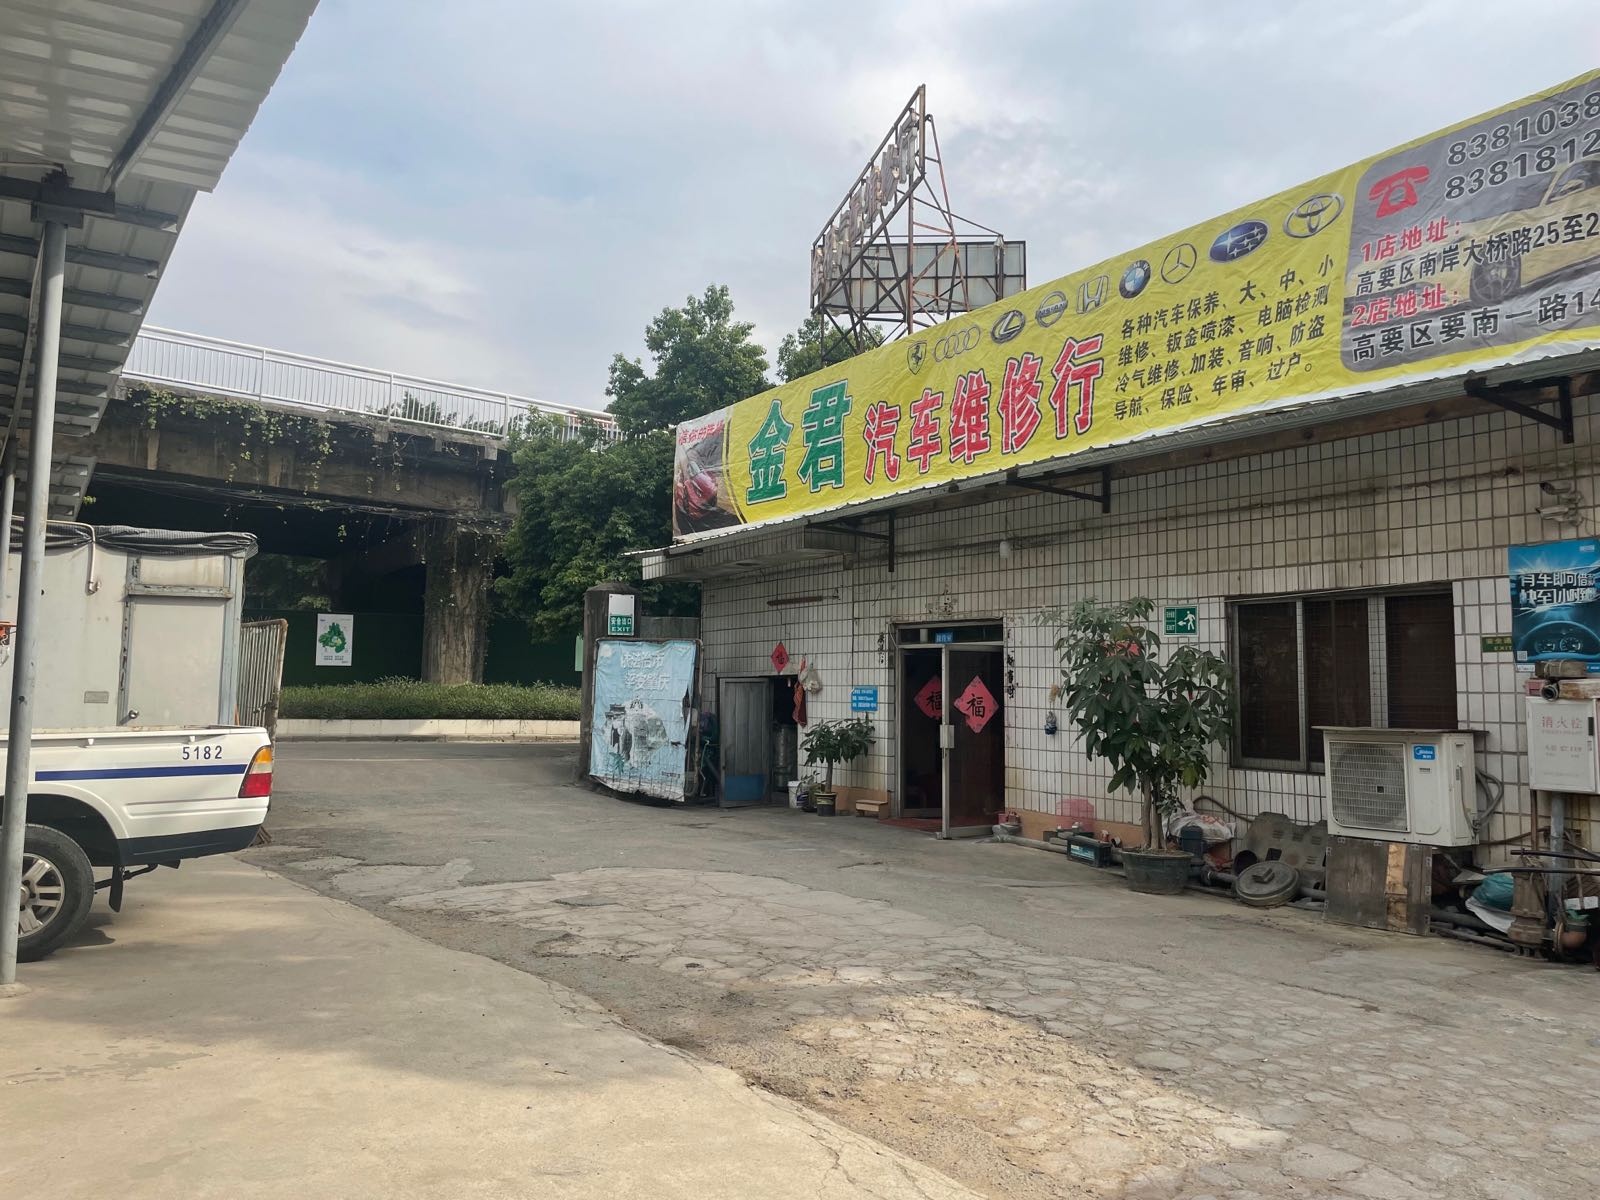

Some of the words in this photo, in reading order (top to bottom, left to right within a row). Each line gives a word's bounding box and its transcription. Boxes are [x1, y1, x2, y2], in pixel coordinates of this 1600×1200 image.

[1447, 91, 1600, 166] 8381038
[1445, 128, 1600, 200] 8381812
[1039, 300, 1066, 316] NISSAN
[966, 693, 986, 718] 福
[1542, 716, 1583, 729] 消火栓
[182, 745, 222, 760] 5182
